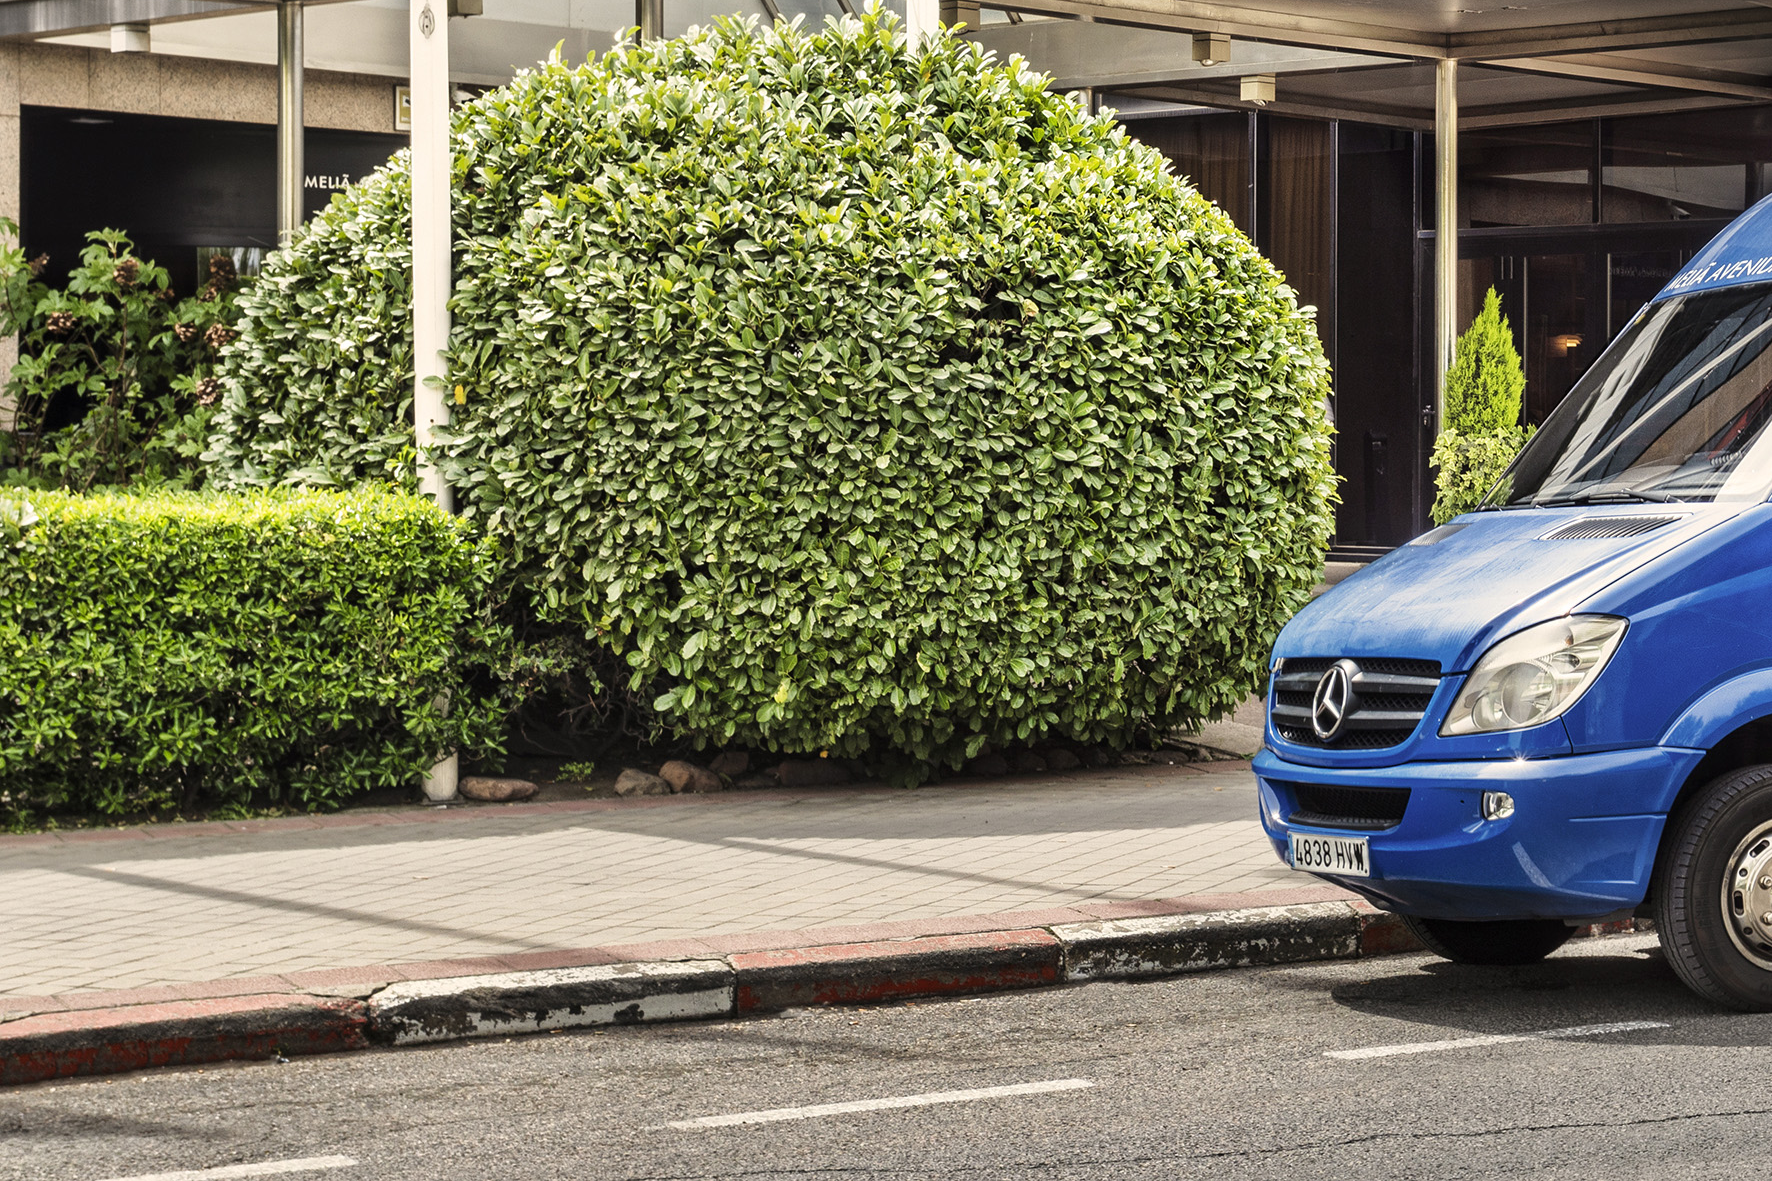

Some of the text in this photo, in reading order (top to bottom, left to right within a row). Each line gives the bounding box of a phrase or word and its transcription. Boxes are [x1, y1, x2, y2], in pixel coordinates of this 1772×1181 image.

[304, 173, 349, 189] MELIÃ
[1663, 261, 1713, 292] MELIÃ
[1295, 838, 1332, 868] 4838
